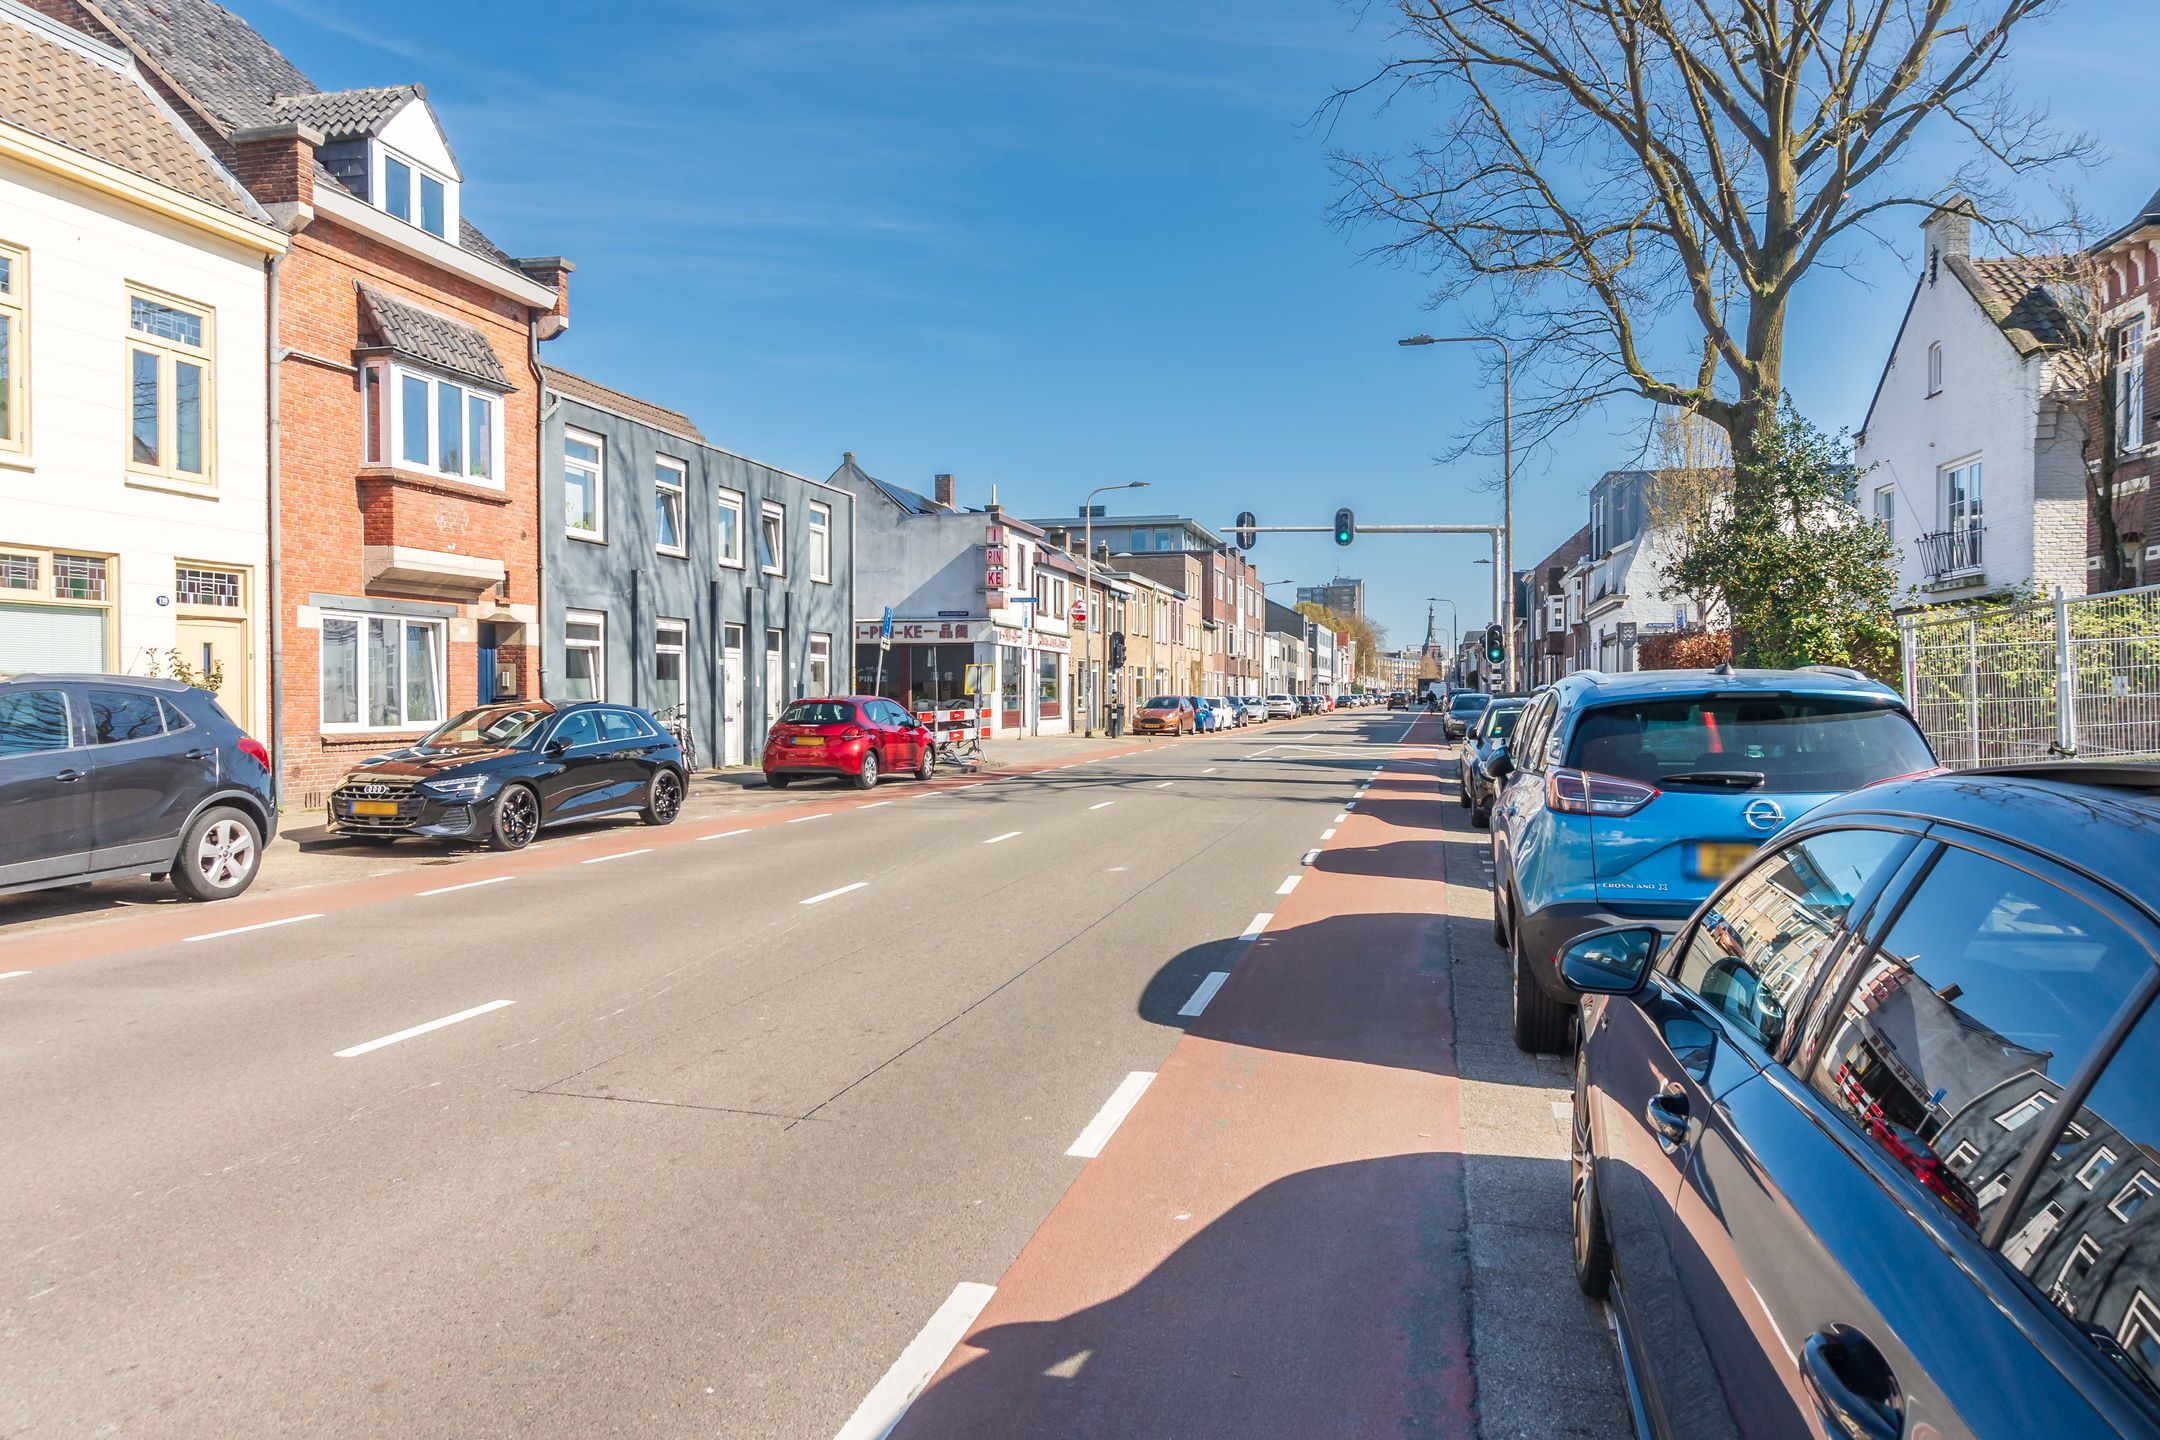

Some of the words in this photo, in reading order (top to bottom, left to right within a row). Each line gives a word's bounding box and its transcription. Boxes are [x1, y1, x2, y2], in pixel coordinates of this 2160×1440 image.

[988, 550, 1001, 562] PIN
[988, 572, 1001, 584] KE
[1658, 883, 1668, 891] X
